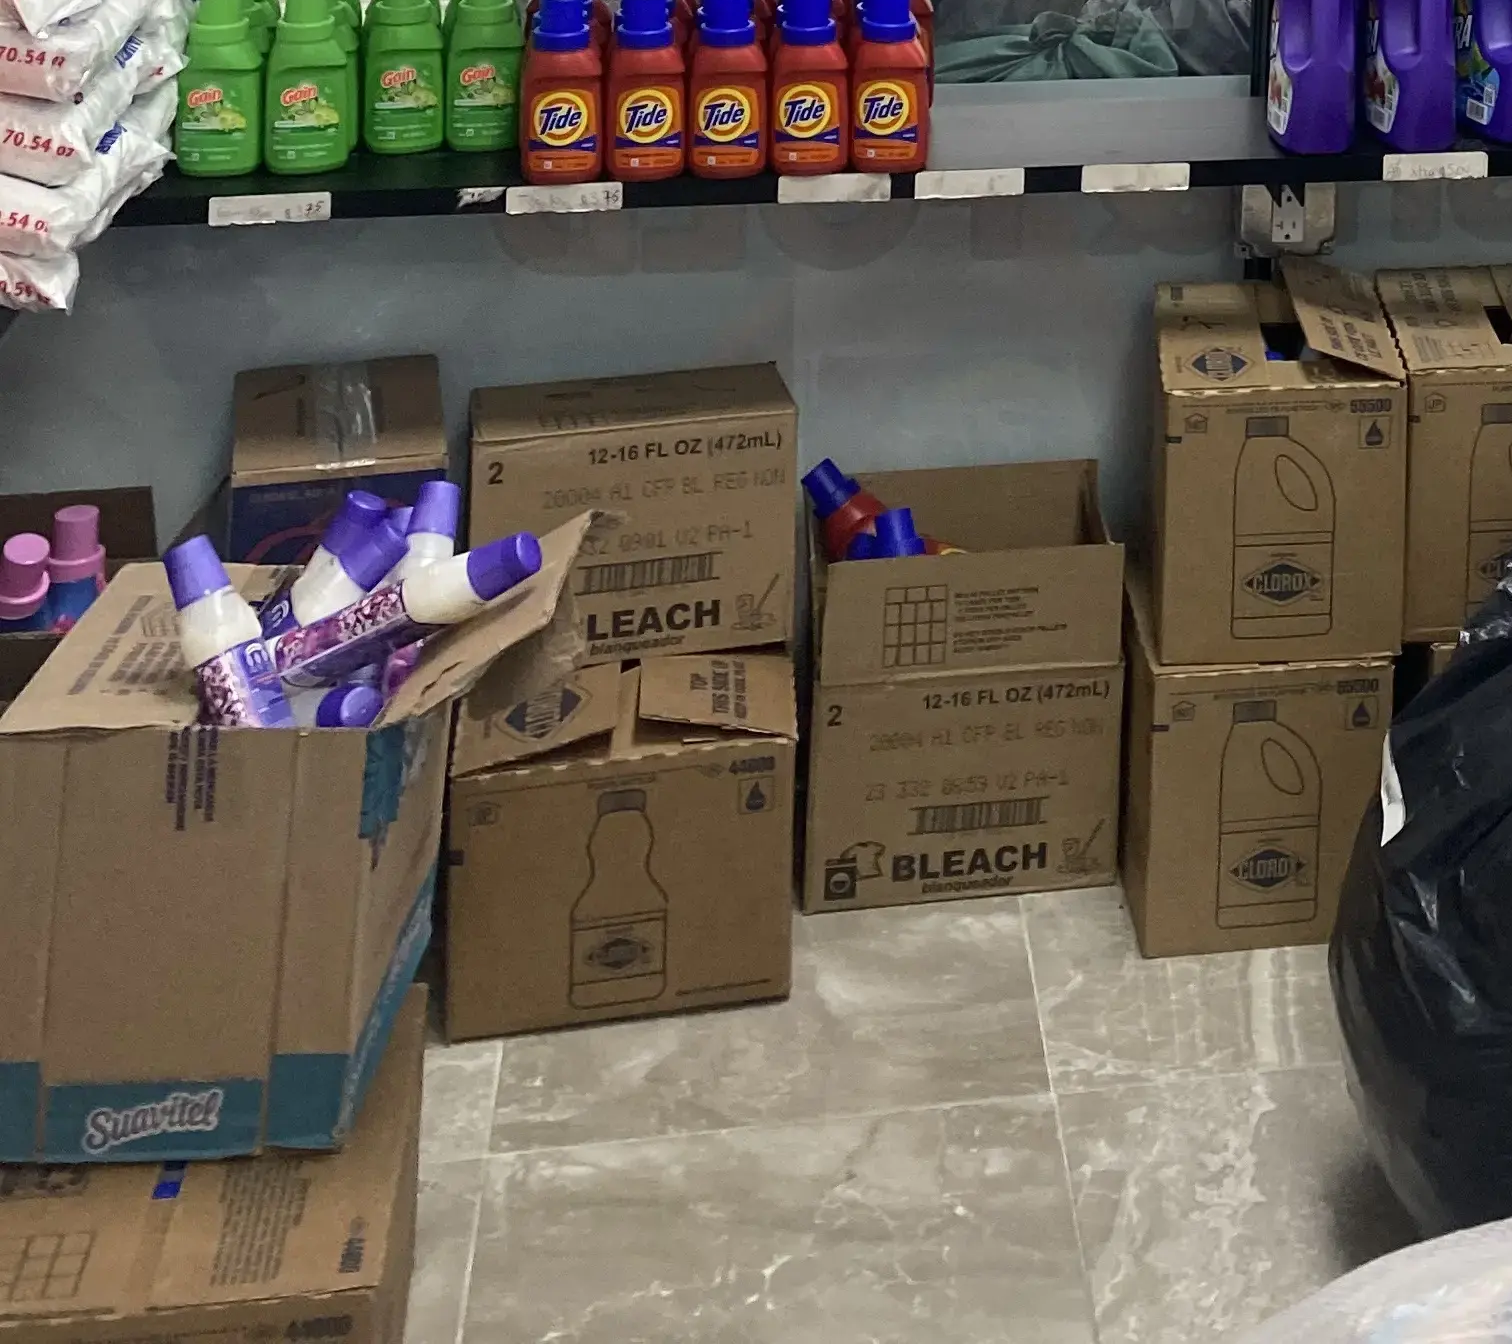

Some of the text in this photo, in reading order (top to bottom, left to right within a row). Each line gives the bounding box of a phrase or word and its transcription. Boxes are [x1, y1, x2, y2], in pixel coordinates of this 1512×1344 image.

[0, 46, 46, 67] 70.54
[380, 68, 417, 89] Gain
[460, 64, 496, 85] Gain
[187, 88, 223, 107] Gain
[280, 85, 319, 105] Gain
[863, 95, 904, 125] Tide
[539, 106, 583, 136] Tide
[625, 103, 669, 133] Tide
[702, 102, 746, 132] Tide
[784, 98, 827, 128] Tide
[3, 127, 75, 158] 70.54 oz
[588, 430, 782, 465] 12-16 FL OZ (472mL)
[487, 461, 504, 486] 2
[1253, 572, 1313, 593] CLOROX
[586, 599, 721, 642] LEACH
[922, 679, 1110, 711] 12-16 FL OZ (472mL)
[827, 705, 843, 727] 2
[891, 841, 1048, 883] BLEACH
[84, 1089, 223, 1153] Suavitel
